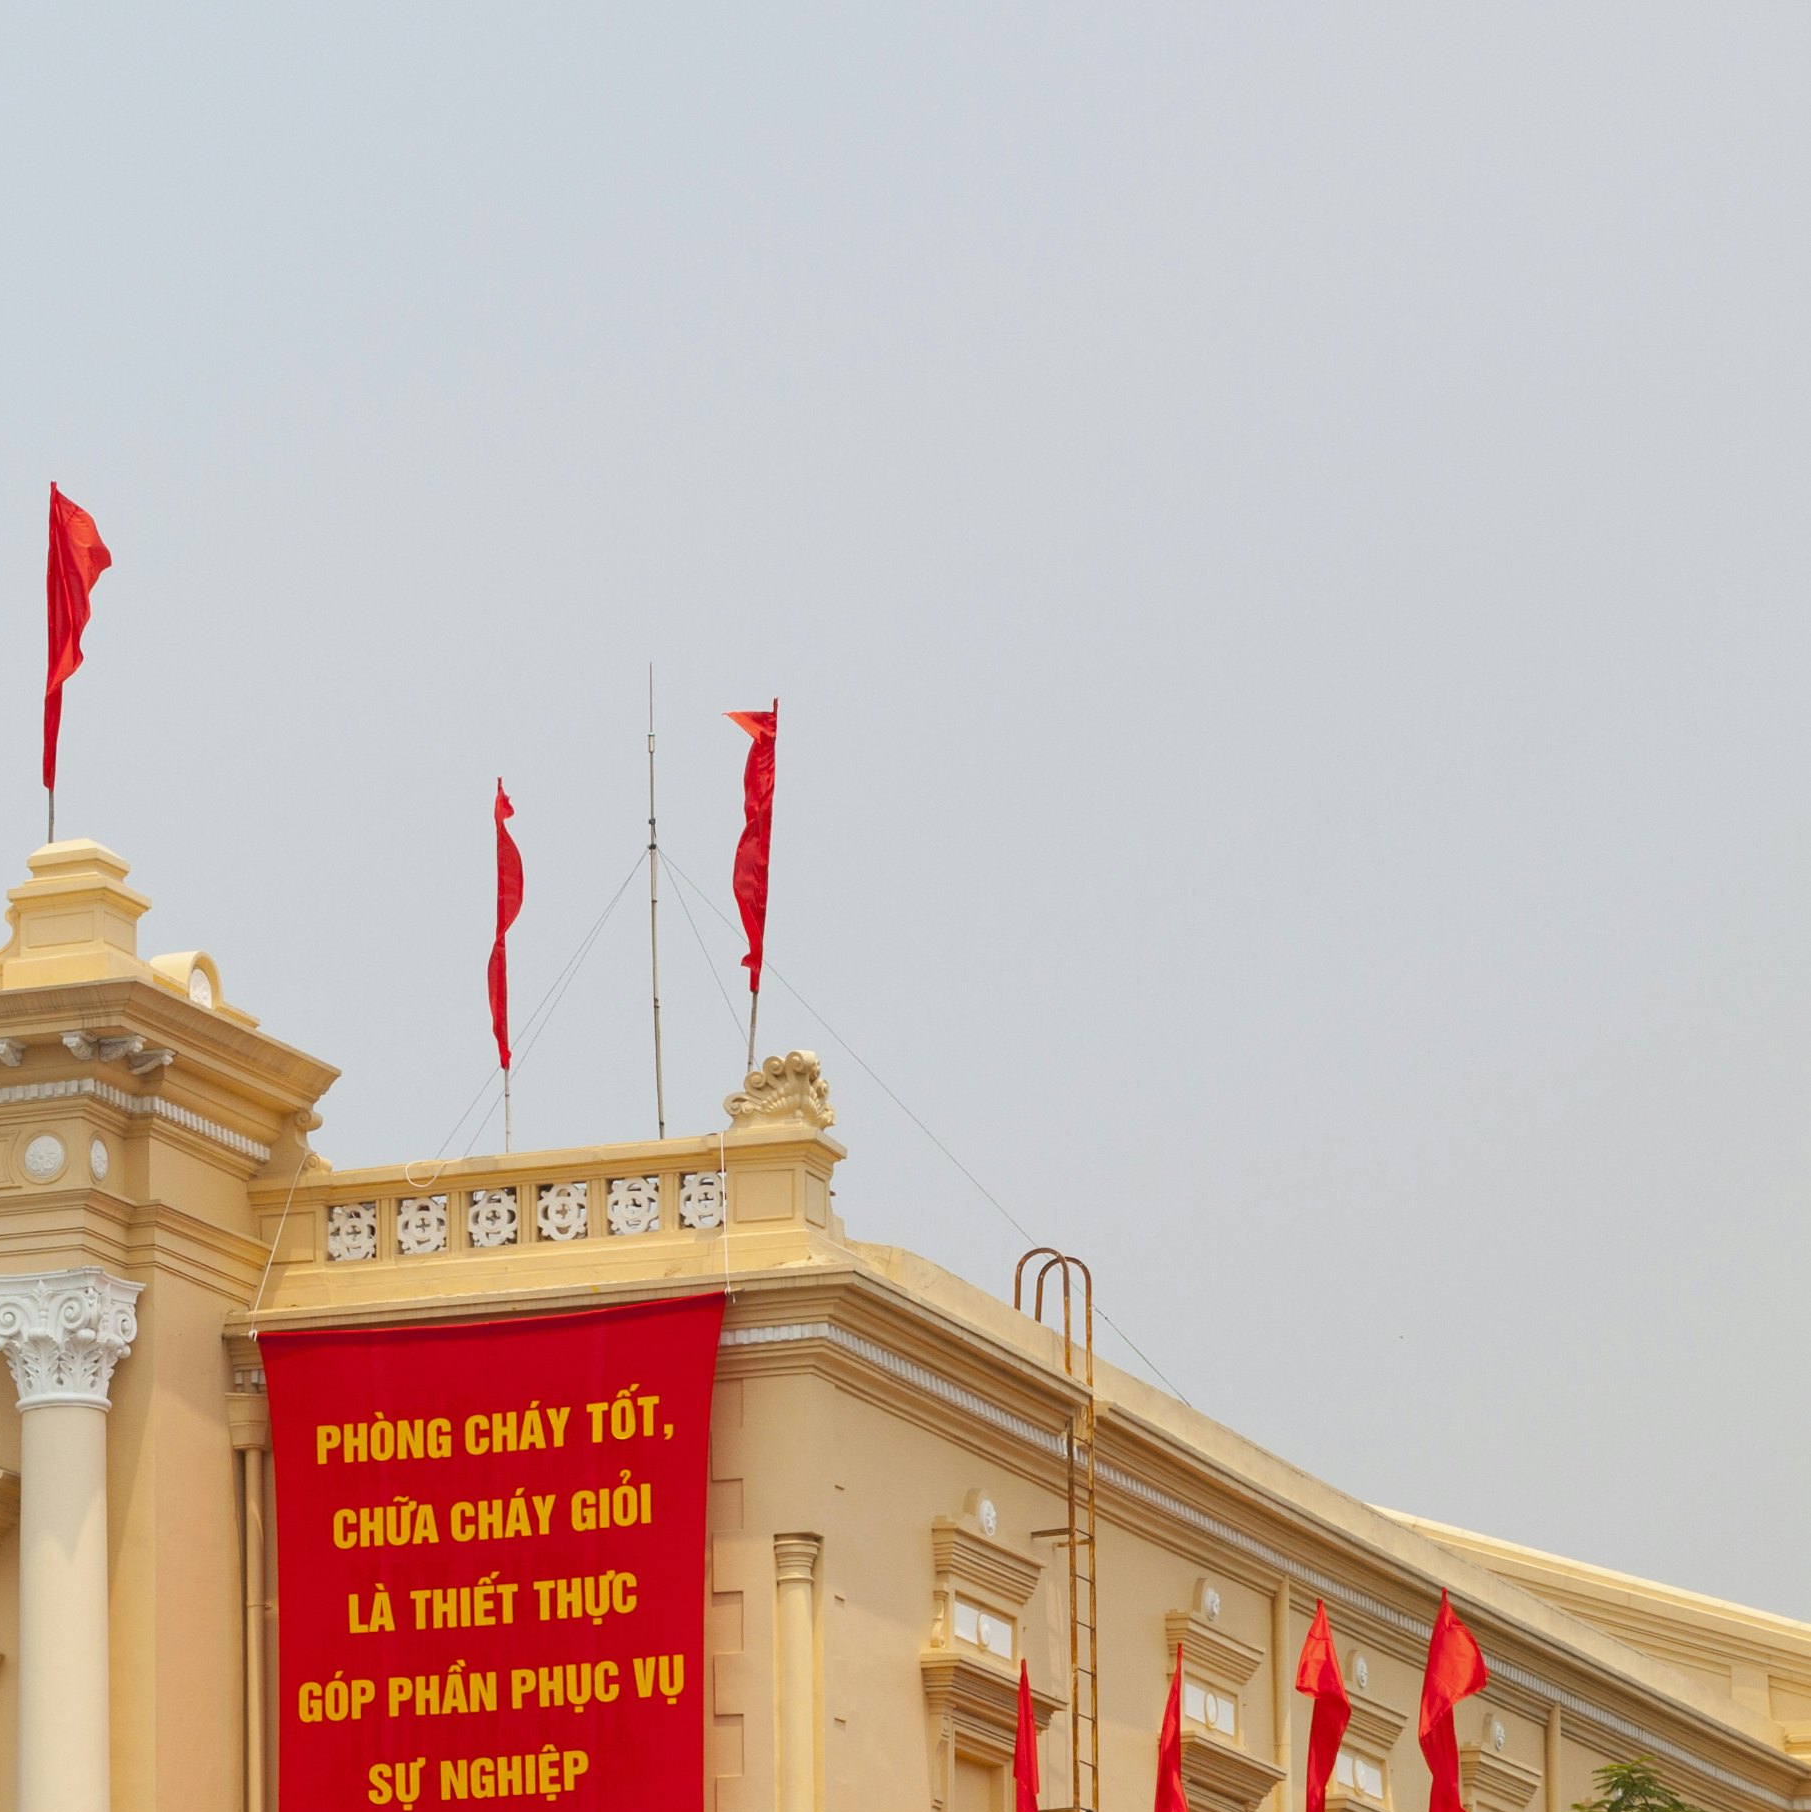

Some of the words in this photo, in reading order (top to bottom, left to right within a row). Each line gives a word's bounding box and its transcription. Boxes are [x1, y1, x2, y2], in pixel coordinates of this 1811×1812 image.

[316, 1411, 452, 1465] PHÒNG
[464, 1400, 571, 1456] CHÁY
[586, 1383, 674, 1443] TỐT,
[333, 1495, 440, 1549] CHỮA
[450, 1487, 556, 1542] CHÁY
[571, 1469, 652, 1532] GIỎI
[348, 1583, 396, 1634] LÀ
[410, 1571, 519, 1630] THIẾT
[533, 1569, 637, 1625] THỰC
[298, 1670, 376, 1723] GÓP
[388, 1659, 497, 1717] PHẦN
[511, 1660, 620, 1713] PHỤC
[632, 1654, 684, 1705] VỤ
[368, 1757, 426, 1811] SỰ
[440, 1744, 589, 1802] NGHIỆP
